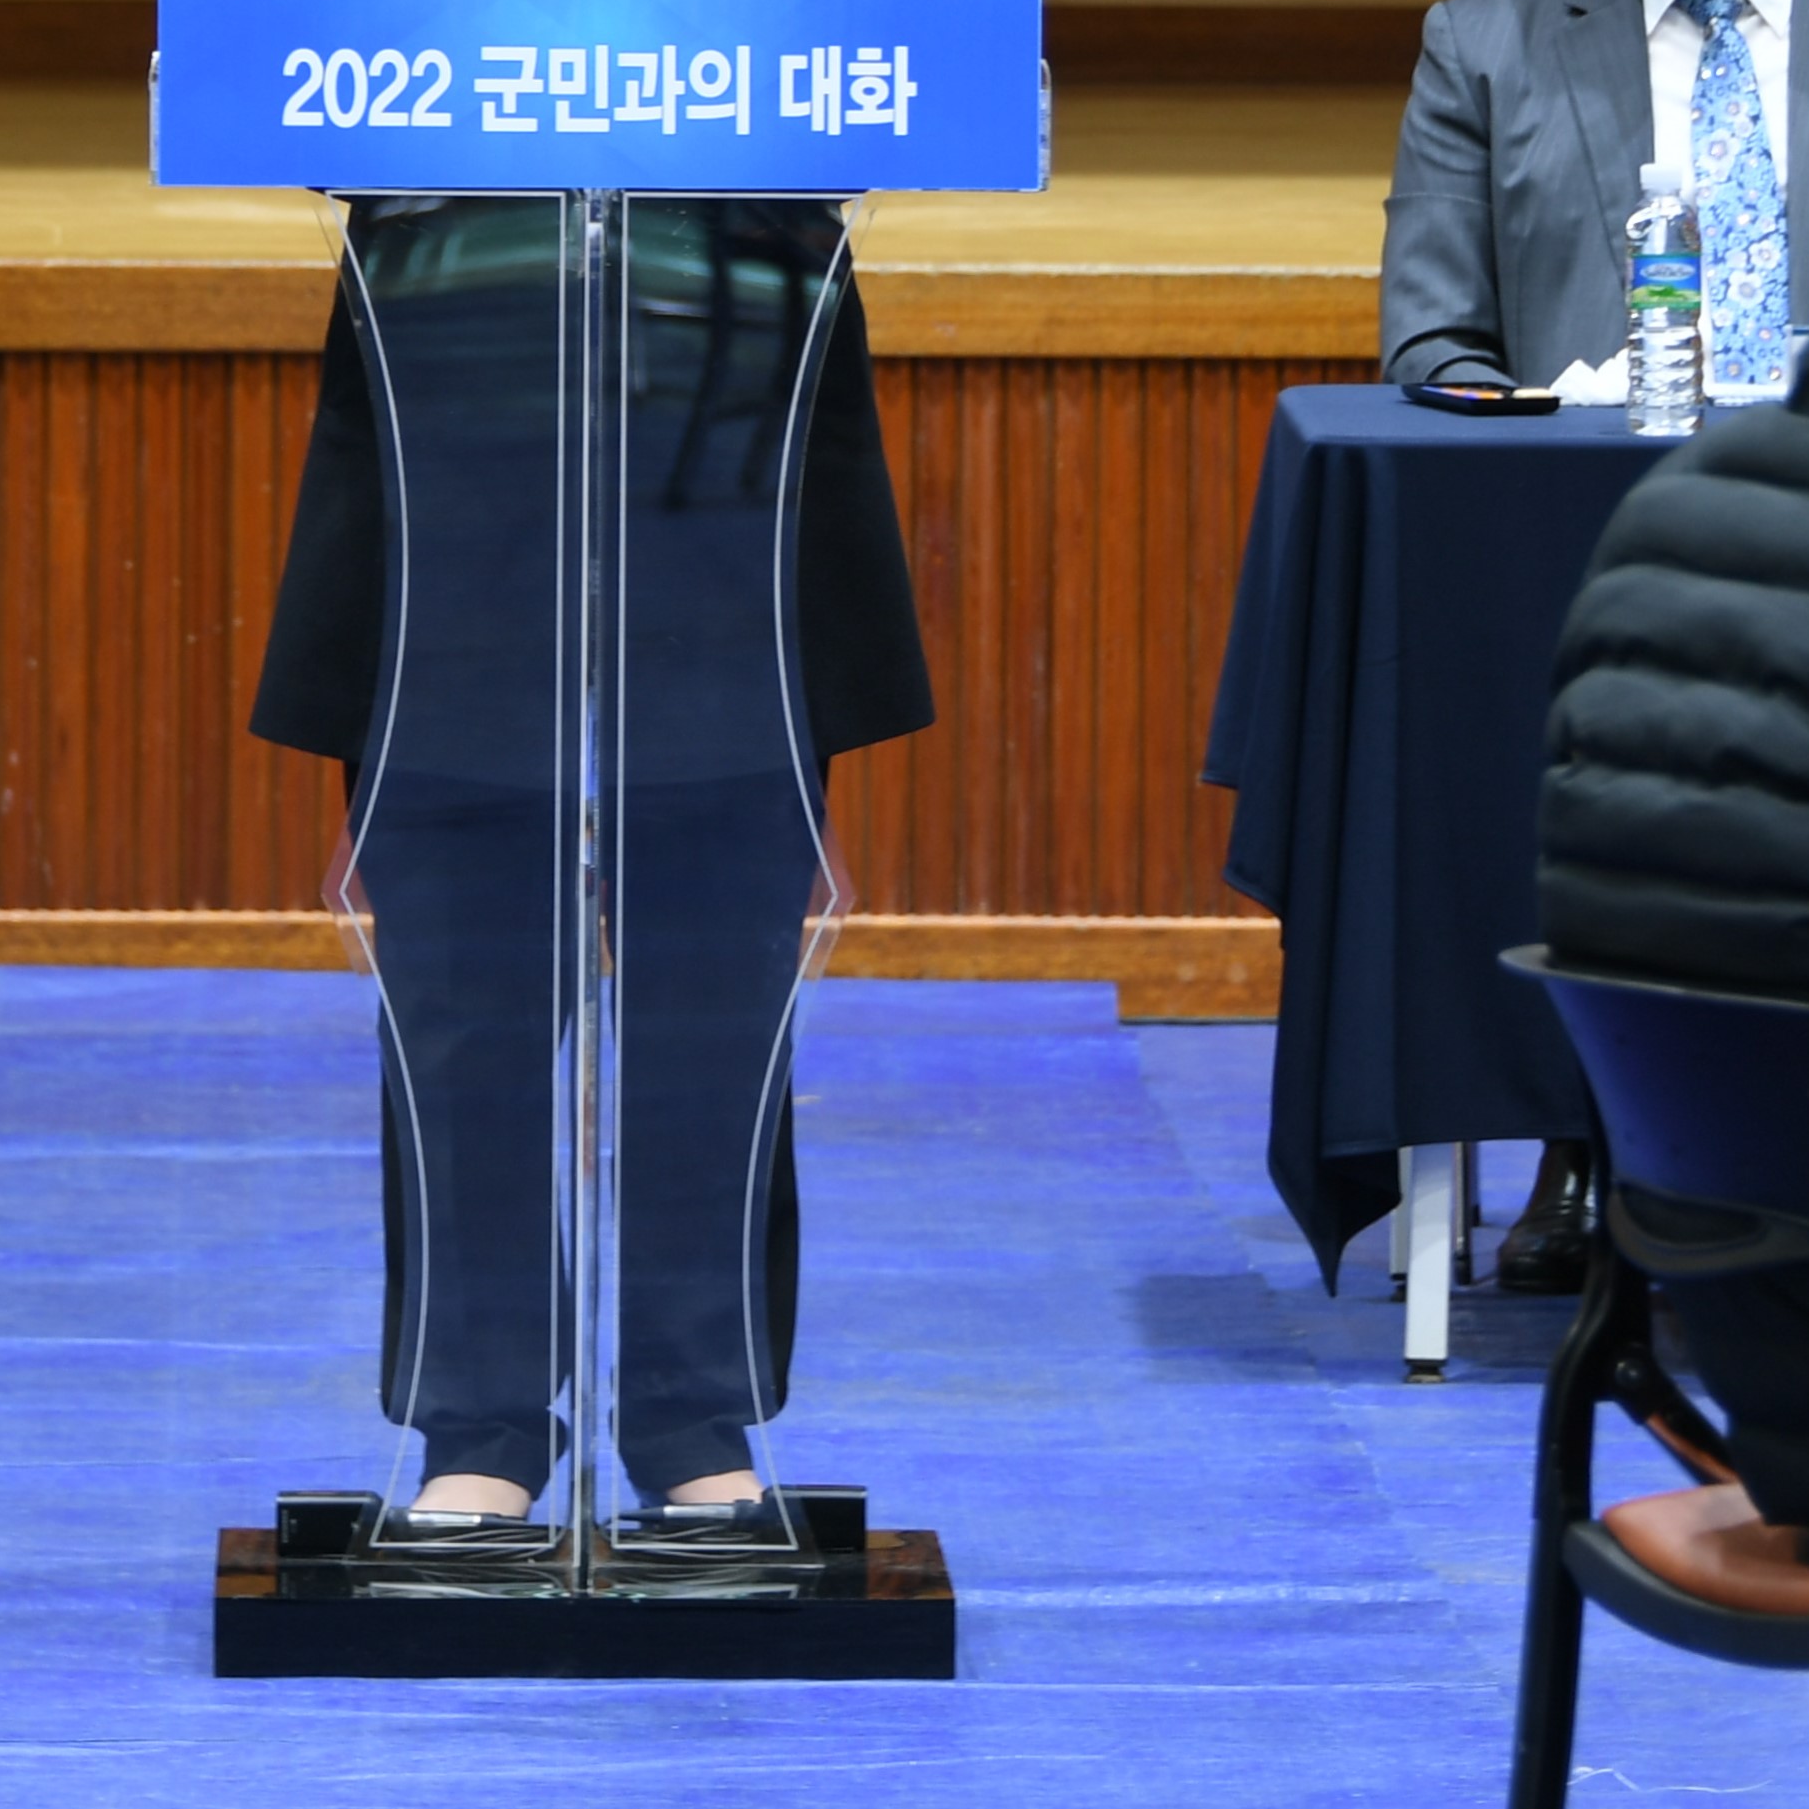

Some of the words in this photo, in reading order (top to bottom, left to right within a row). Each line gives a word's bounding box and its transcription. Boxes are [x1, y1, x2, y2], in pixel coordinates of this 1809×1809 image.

[281, 47, 453, 129] 2022
[473, 43, 752, 136] 군민과의
[779, 44, 918, 137] 대화
